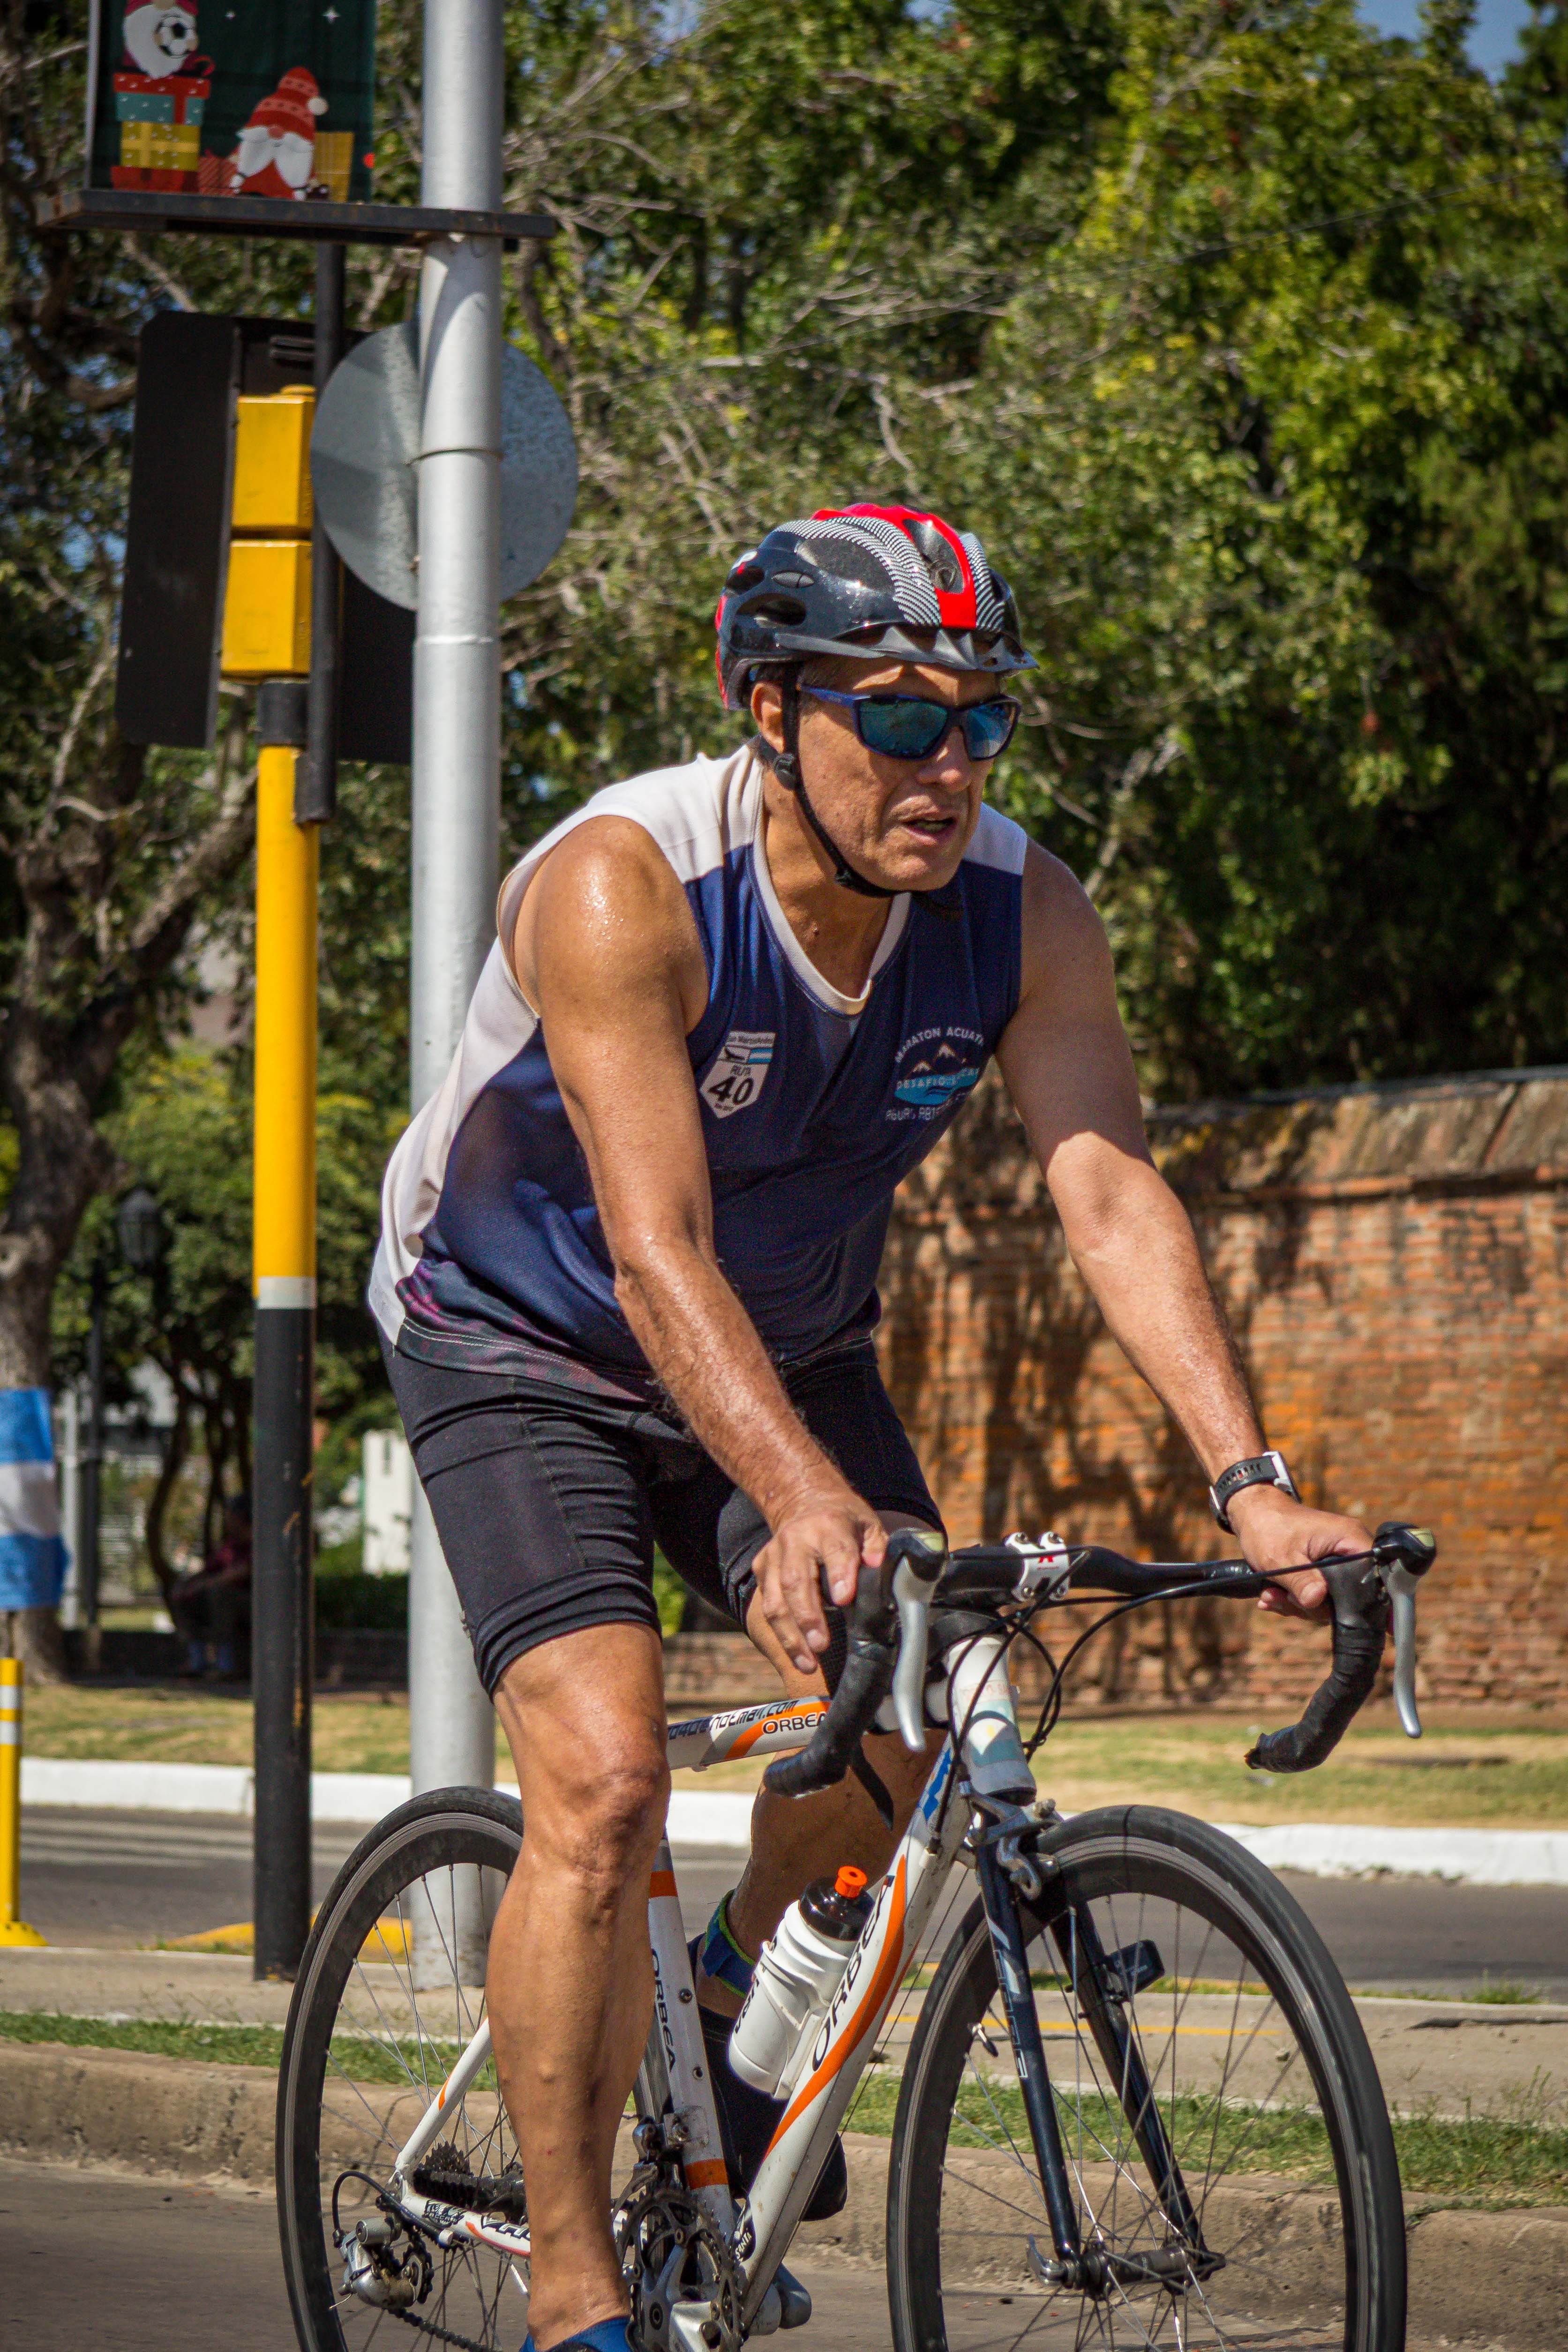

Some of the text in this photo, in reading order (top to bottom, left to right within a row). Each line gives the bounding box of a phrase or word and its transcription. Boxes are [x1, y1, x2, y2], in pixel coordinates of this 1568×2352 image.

[895, 1027, 940, 1063] MARATON
[708, 1076, 754, 1105] 40
[735, 2232, 752, 2259] SANTA
